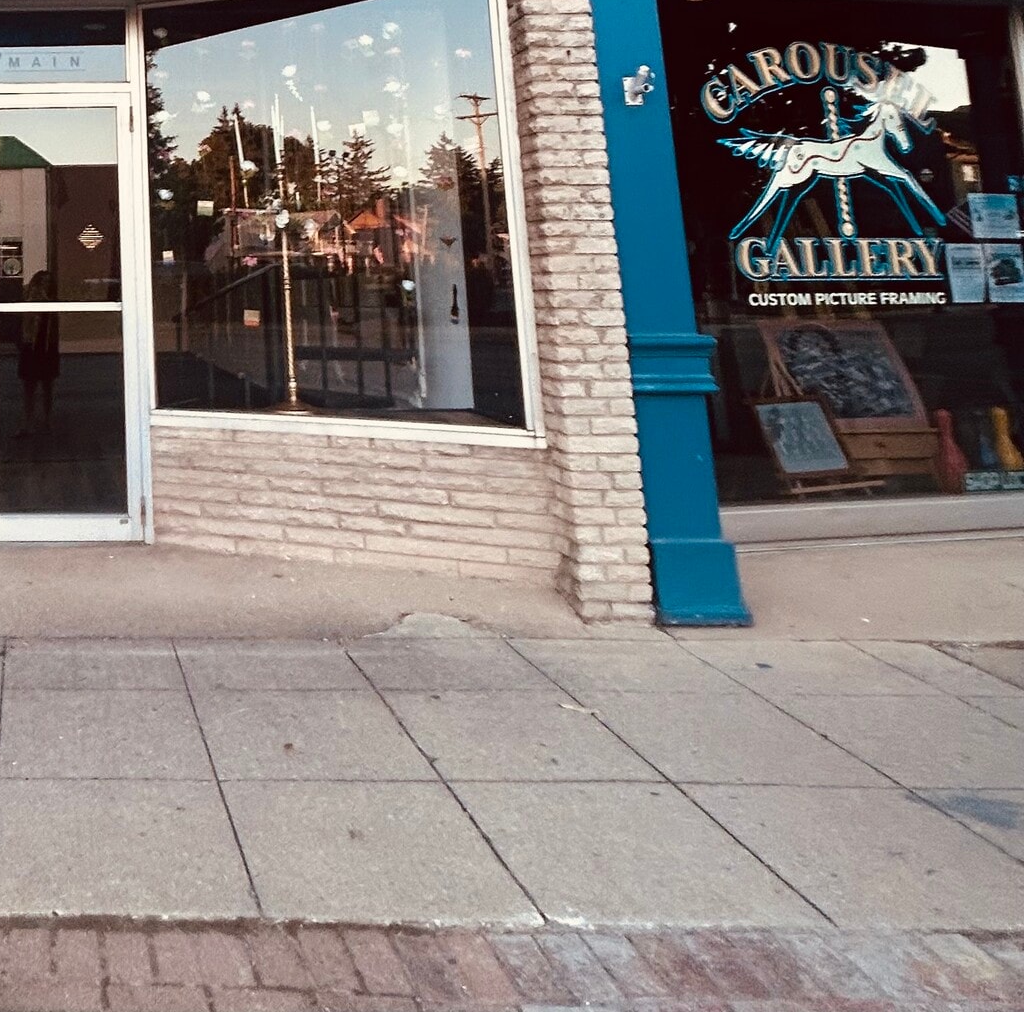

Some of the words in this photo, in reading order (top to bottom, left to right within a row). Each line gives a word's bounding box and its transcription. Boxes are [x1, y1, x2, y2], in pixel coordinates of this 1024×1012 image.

[8, 55, 81, 69] MAIN
[735, 237, 945, 281] GALLERY
[748, 292, 812, 306] CUSTOM
[815, 292, 876, 306] PICTURE
[880, 292, 947, 305] FRAMING
